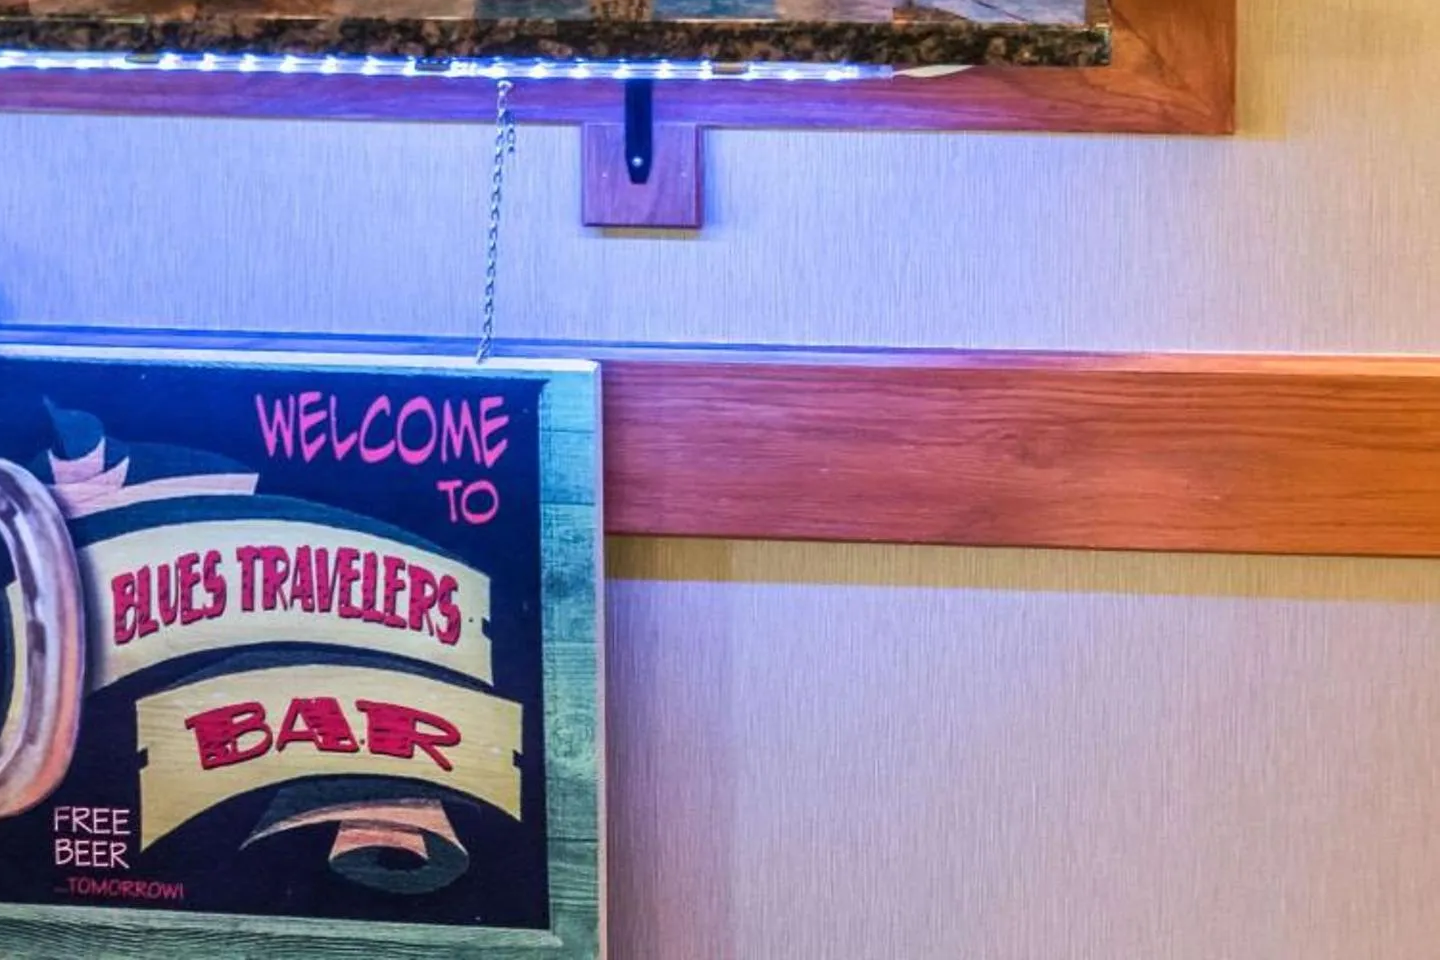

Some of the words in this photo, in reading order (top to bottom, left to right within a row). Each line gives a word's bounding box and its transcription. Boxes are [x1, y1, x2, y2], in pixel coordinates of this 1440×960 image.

[256, 391, 509, 467] WELCOME
[438, 479, 499, 524] TO
[111, 550, 226, 646] BLUES
[236, 545, 461, 646] TRAVELERS
[185, 696, 461, 772] BAR
[54, 806, 131, 835] FREE
[55, 838, 130, 869] BEER
